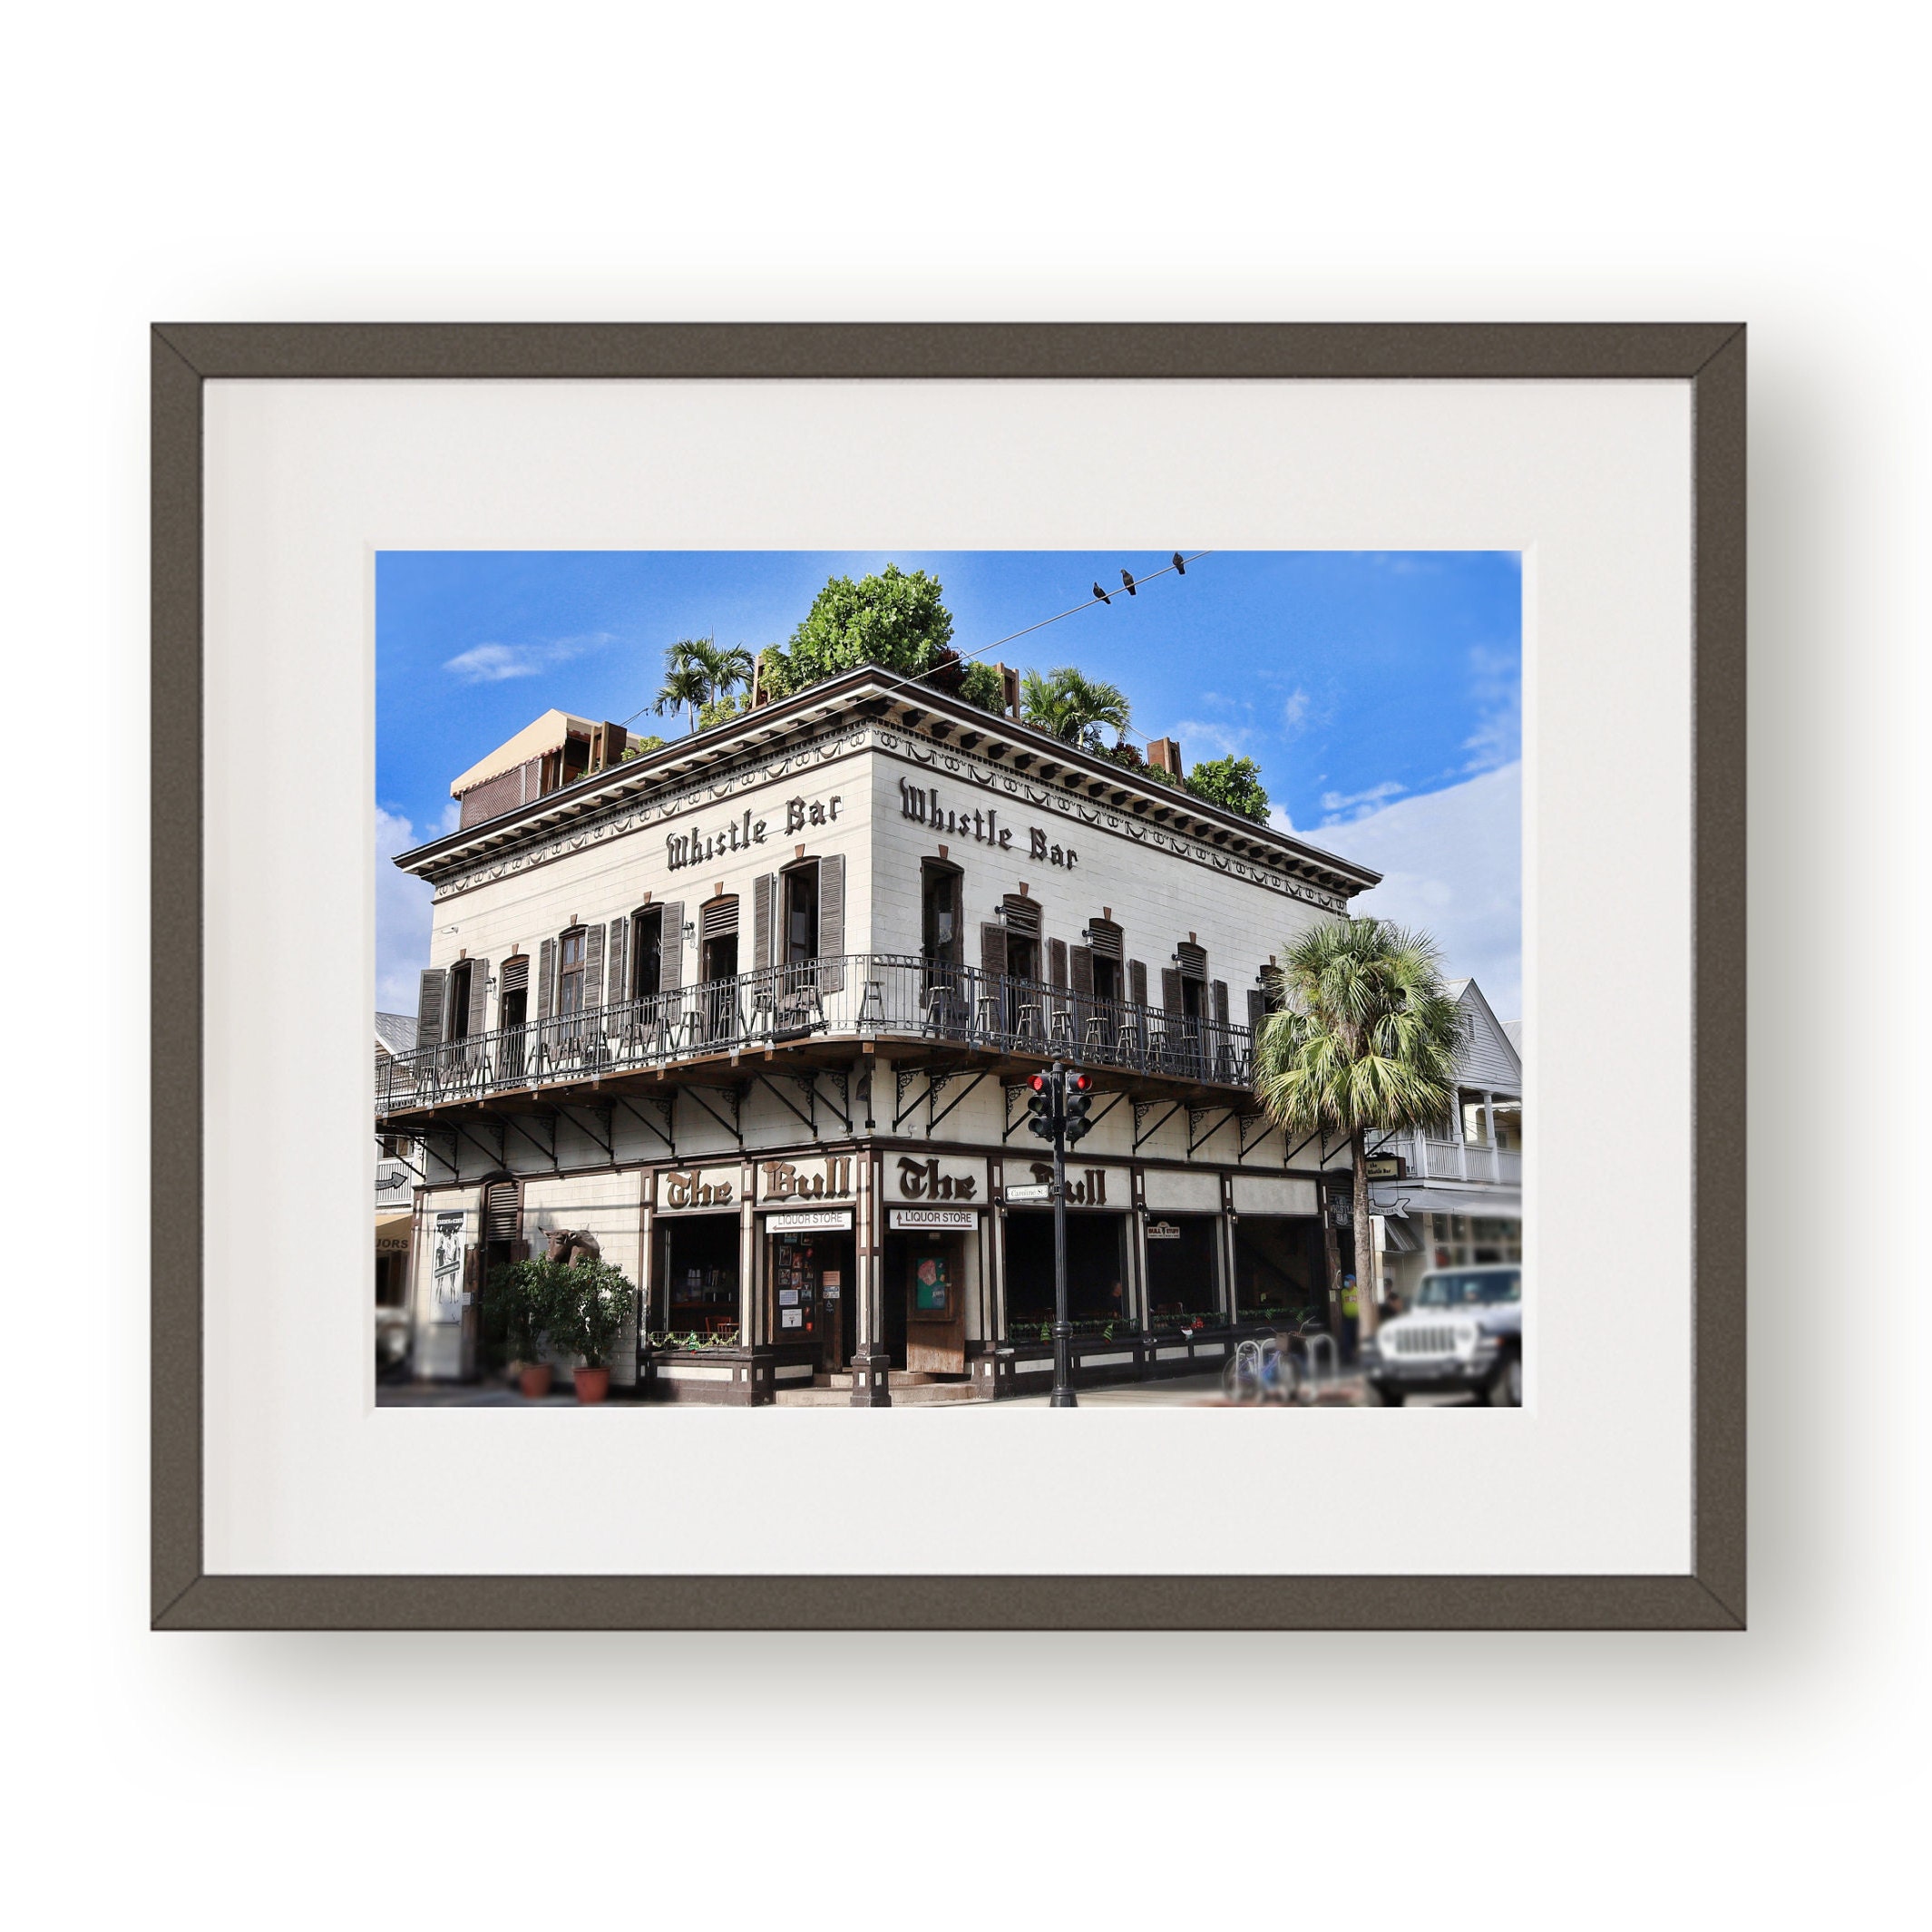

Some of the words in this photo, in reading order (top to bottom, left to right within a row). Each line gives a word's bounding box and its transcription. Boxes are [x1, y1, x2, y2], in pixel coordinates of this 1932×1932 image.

[667, 808, 767, 872] Whistle
[784, 795, 842, 836] Bar
[899, 776, 1013, 850] Whistle
[1029, 826, 1078, 871] Bar
[667, 1169, 734, 1209] The
[762, 1156, 853, 1202] Bull
[897, 1156, 977, 1200] The
[1010, 1189, 1035, 1197] Caroline
[777, 1215, 811, 1225] LIQUOR
[813, 1212, 843, 1224] STORE
[905, 1211, 941, 1222] LIQUOR
[942, 1212, 972, 1223] STORE
